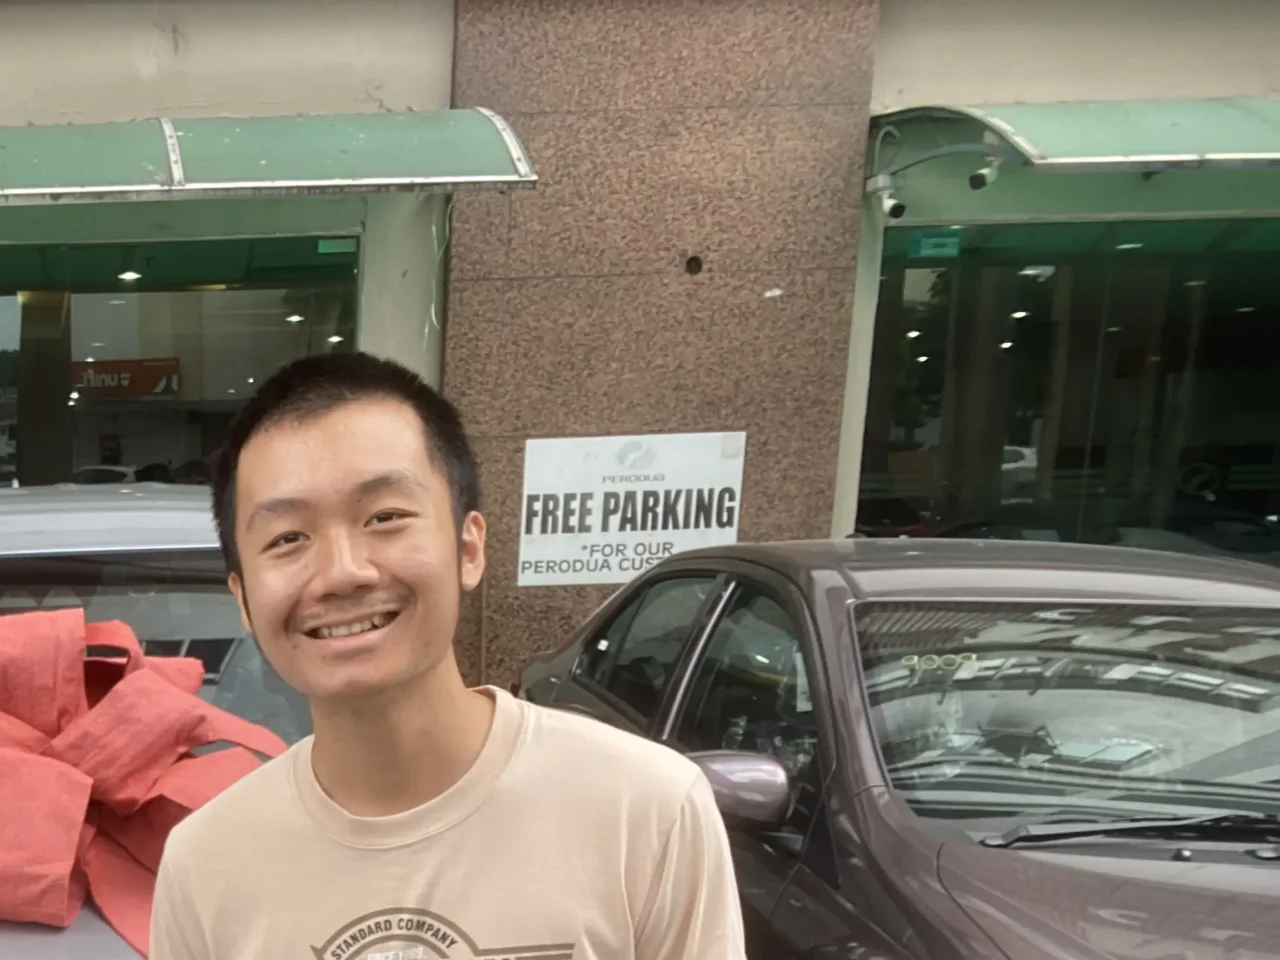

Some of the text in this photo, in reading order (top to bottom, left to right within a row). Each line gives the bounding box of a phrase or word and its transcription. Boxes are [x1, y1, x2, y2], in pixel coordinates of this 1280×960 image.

[524, 486, 737, 535] FREE PARKING
[634, 541, 674, 556] OUR
[521, 556, 665, 574] PERODUA CUS
[331, 918, 459, 960] STANDARD COMPANY
